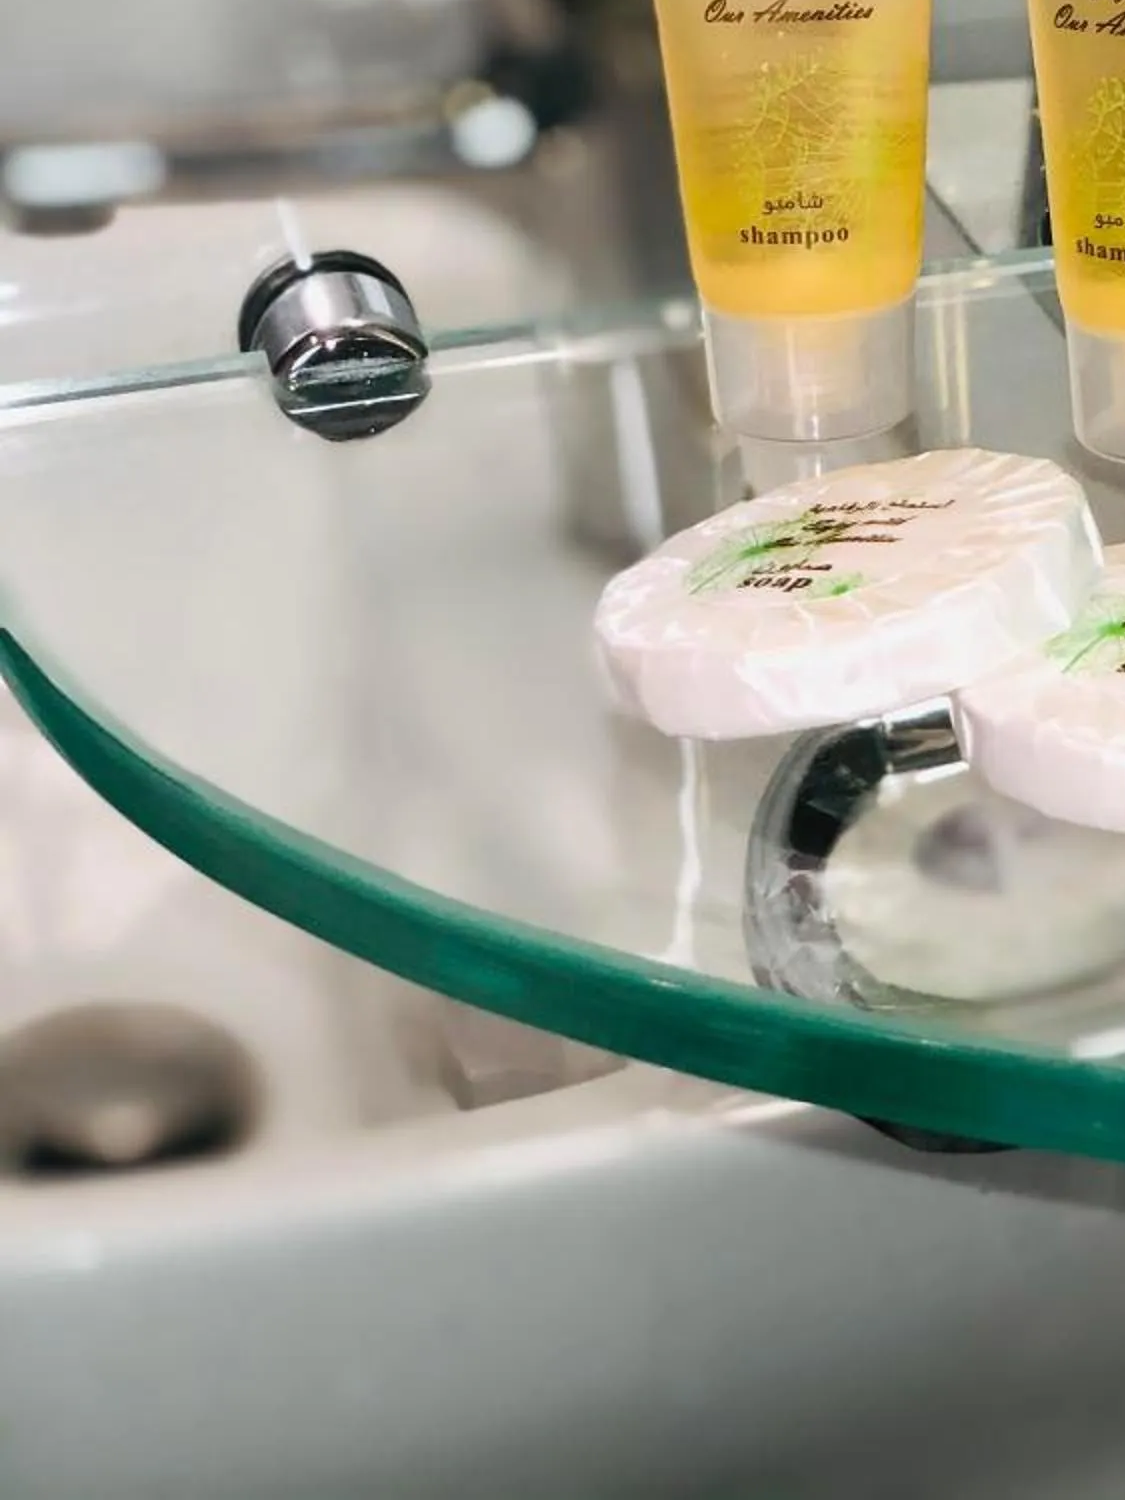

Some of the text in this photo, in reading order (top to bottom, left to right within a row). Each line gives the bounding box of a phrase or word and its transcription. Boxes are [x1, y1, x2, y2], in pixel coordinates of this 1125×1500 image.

[1053, 3, 1089, 33] Our
[740, 224, 850, 250] shampoo
[736, 575, 814, 593] soap
